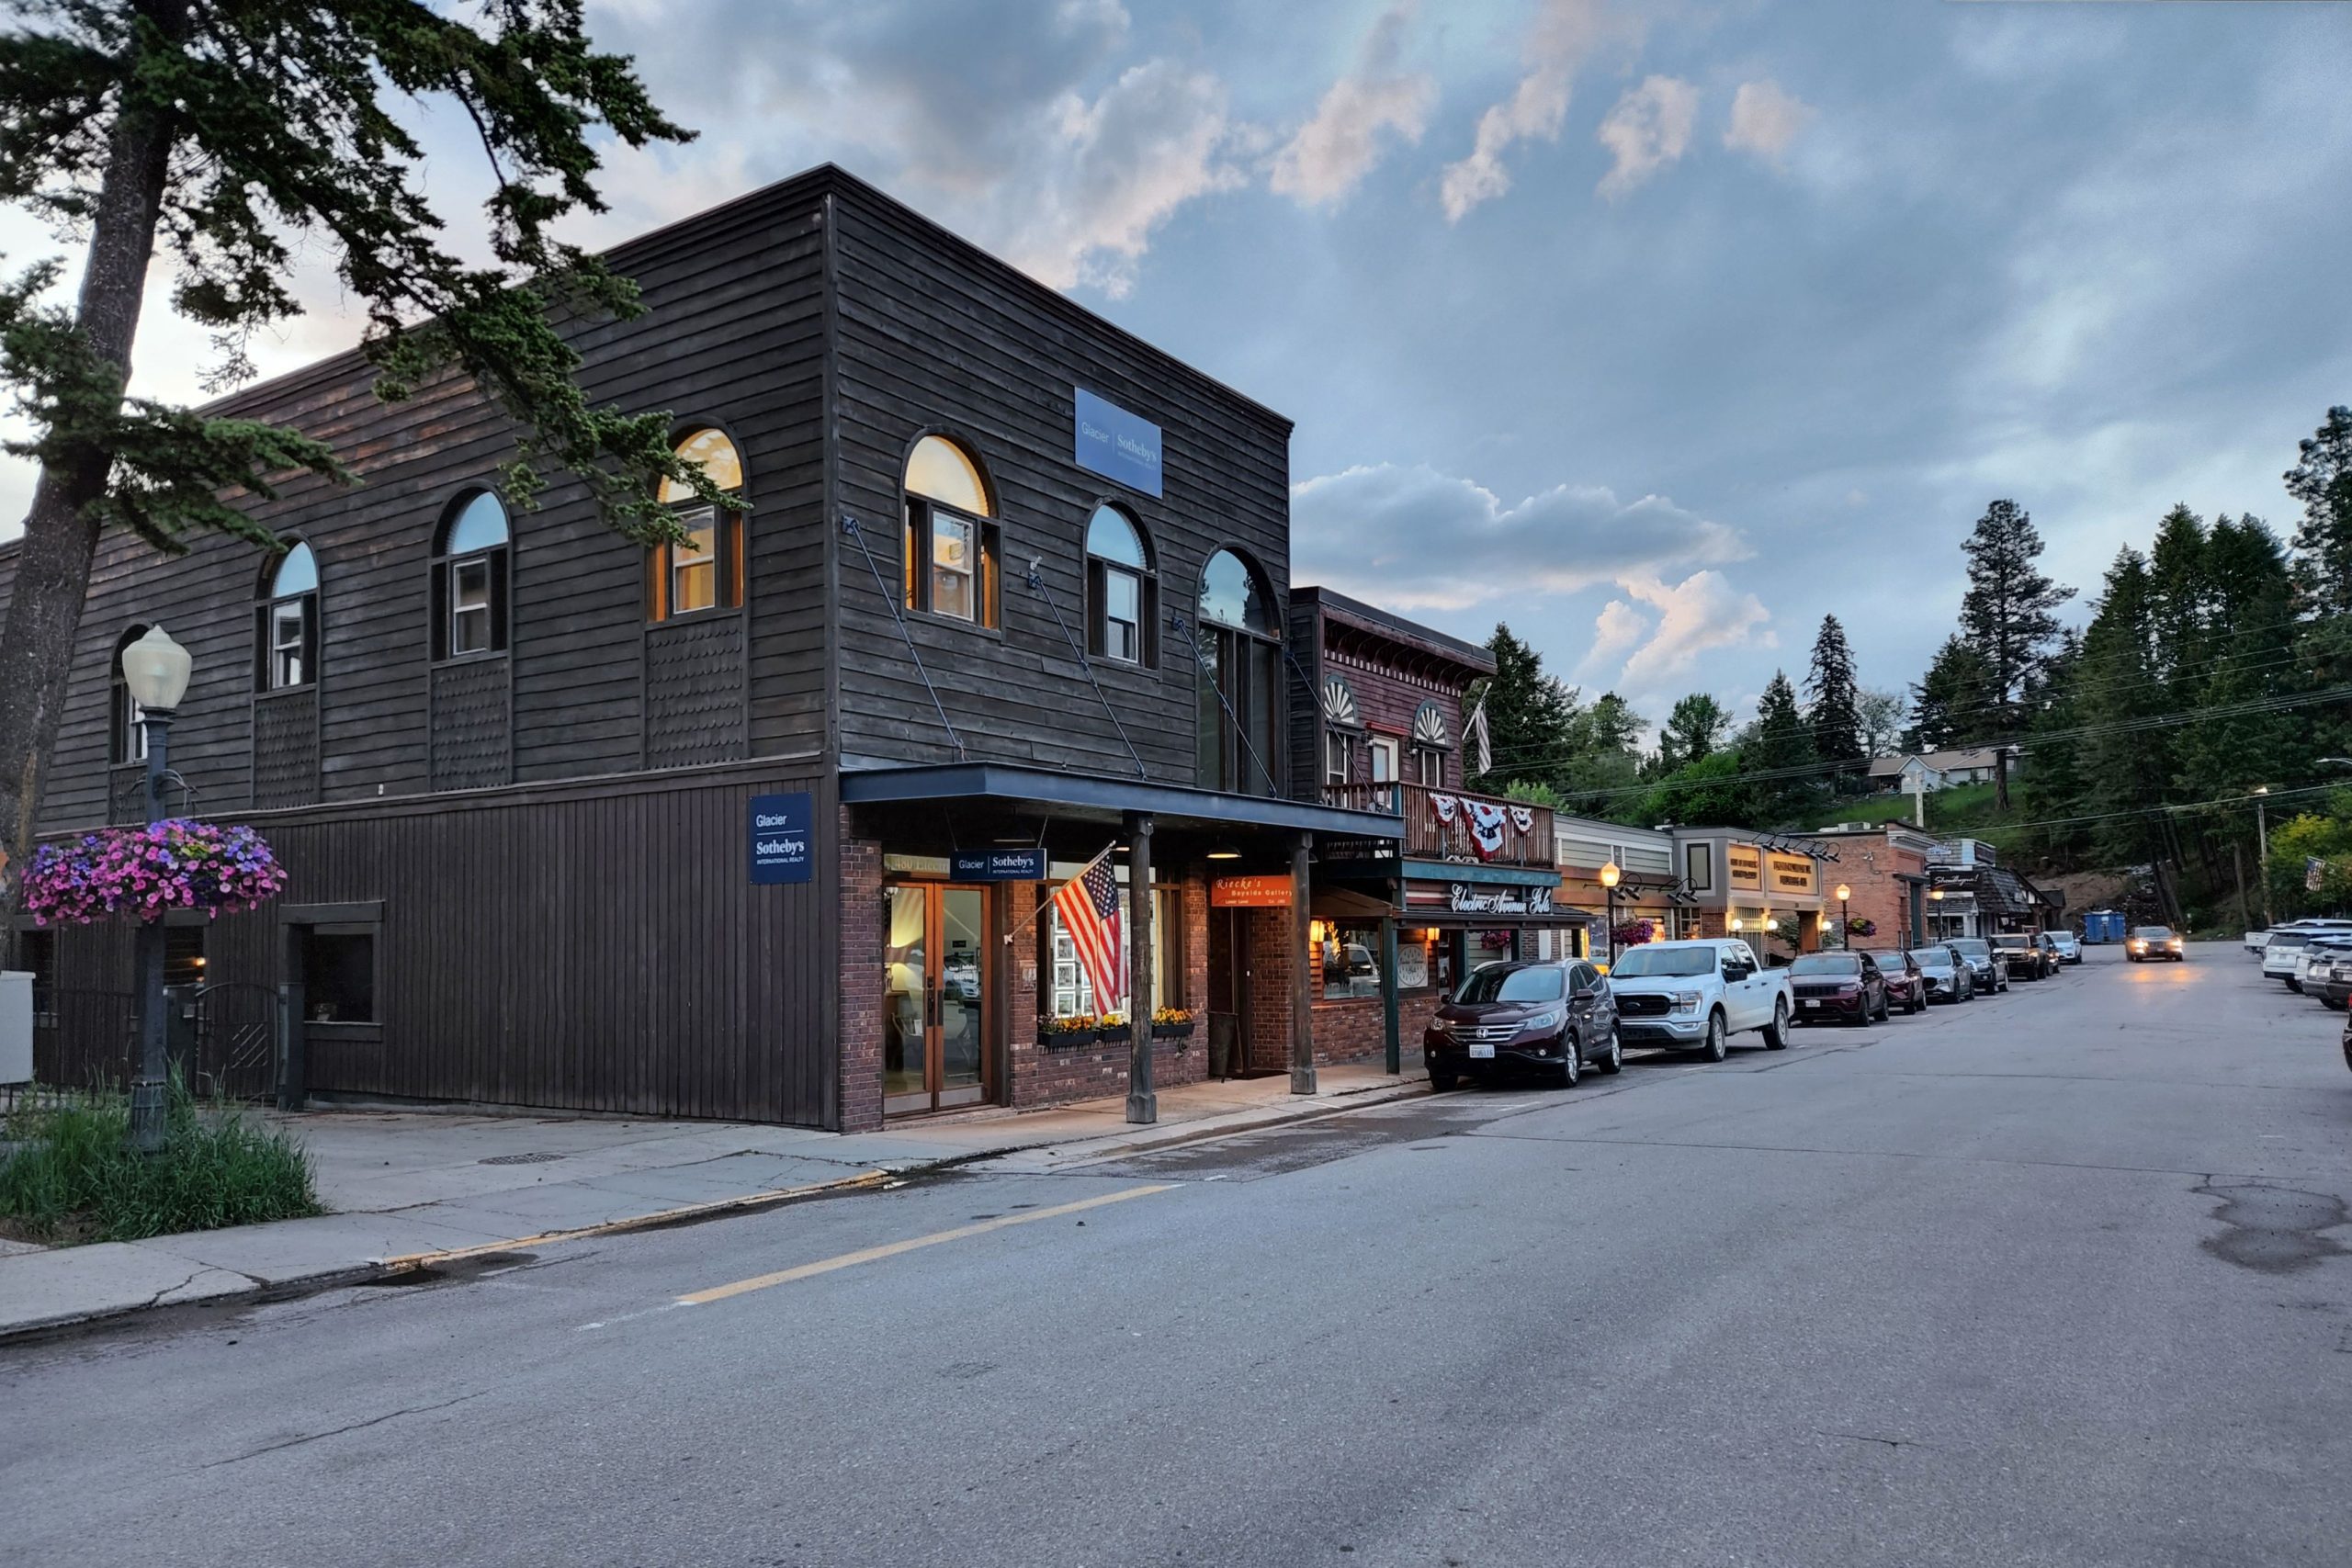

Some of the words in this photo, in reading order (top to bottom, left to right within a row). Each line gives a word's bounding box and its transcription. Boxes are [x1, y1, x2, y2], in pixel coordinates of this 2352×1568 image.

[1081, 422, 1110, 443] Glacier
[1117, 434, 1158, 462] Sotheby's
[755, 813, 787, 828] Glacier
[756, 838, 805, 856] Sotheby's
[756, 857, 789, 865] INTERNATIONAL
[958, 859, 985, 870] Glacier
[992, 855, 1035, 869] Sotheby's
[1216, 877, 1261, 890] Riecke's
[1451, 884, 1488, 913] Electric
[1487, 888, 1527, 914] Avenue
